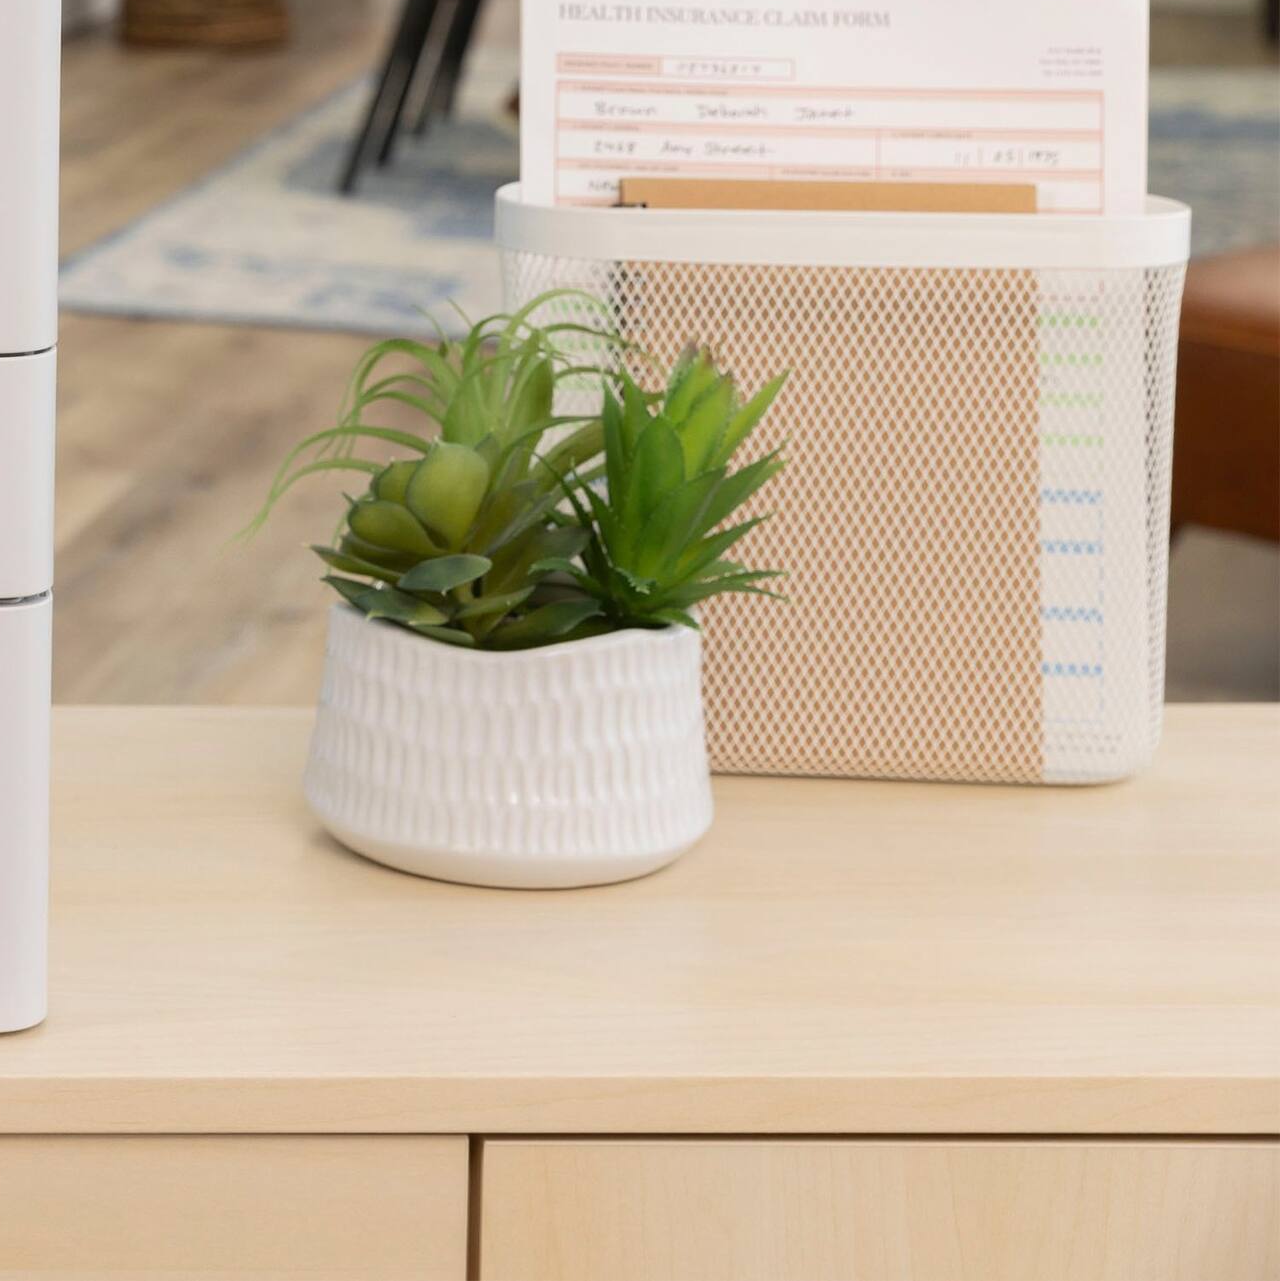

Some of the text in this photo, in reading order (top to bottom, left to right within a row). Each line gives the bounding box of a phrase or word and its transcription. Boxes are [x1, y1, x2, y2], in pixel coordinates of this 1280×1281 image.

[559, 2, 891, 29] HEALTH INSURANCE CLAIM FORM
